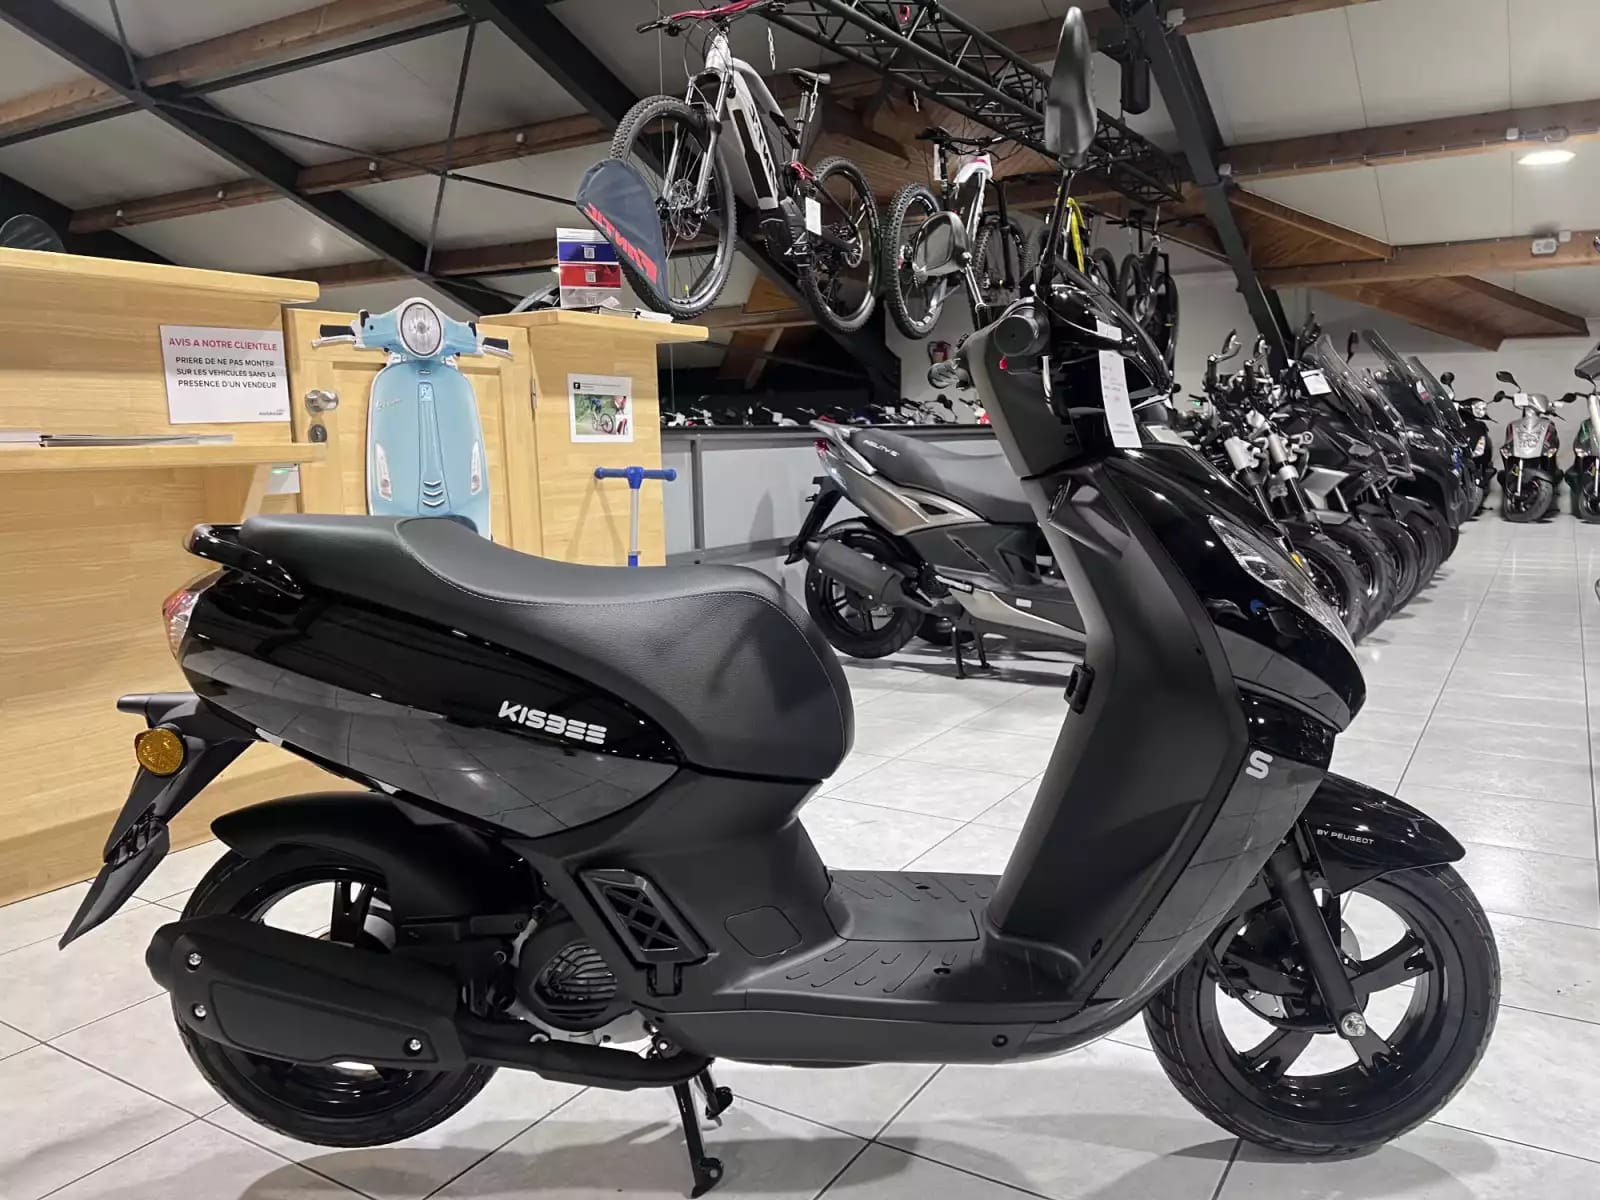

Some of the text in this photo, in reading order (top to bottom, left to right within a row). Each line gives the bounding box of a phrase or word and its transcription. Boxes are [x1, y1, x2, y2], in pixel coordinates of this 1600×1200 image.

[169, 338, 277, 351] AVIS A NOTRE CLIENTELE
[175, 356, 275, 367] PRIERE DE NE PAS MONTER
[193, 368, 207, 376] LES
[208, 369, 247, 377] VEHICULES
[248, 370, 266, 378] SANS
[178, 379, 277, 389] PRESENCE D'UN VENDEUR
[498, 700, 607, 744] KISBEE
[1245, 750, 1273, 779] S
[1316, 828, 1375, 845] BY PEUGEOT
